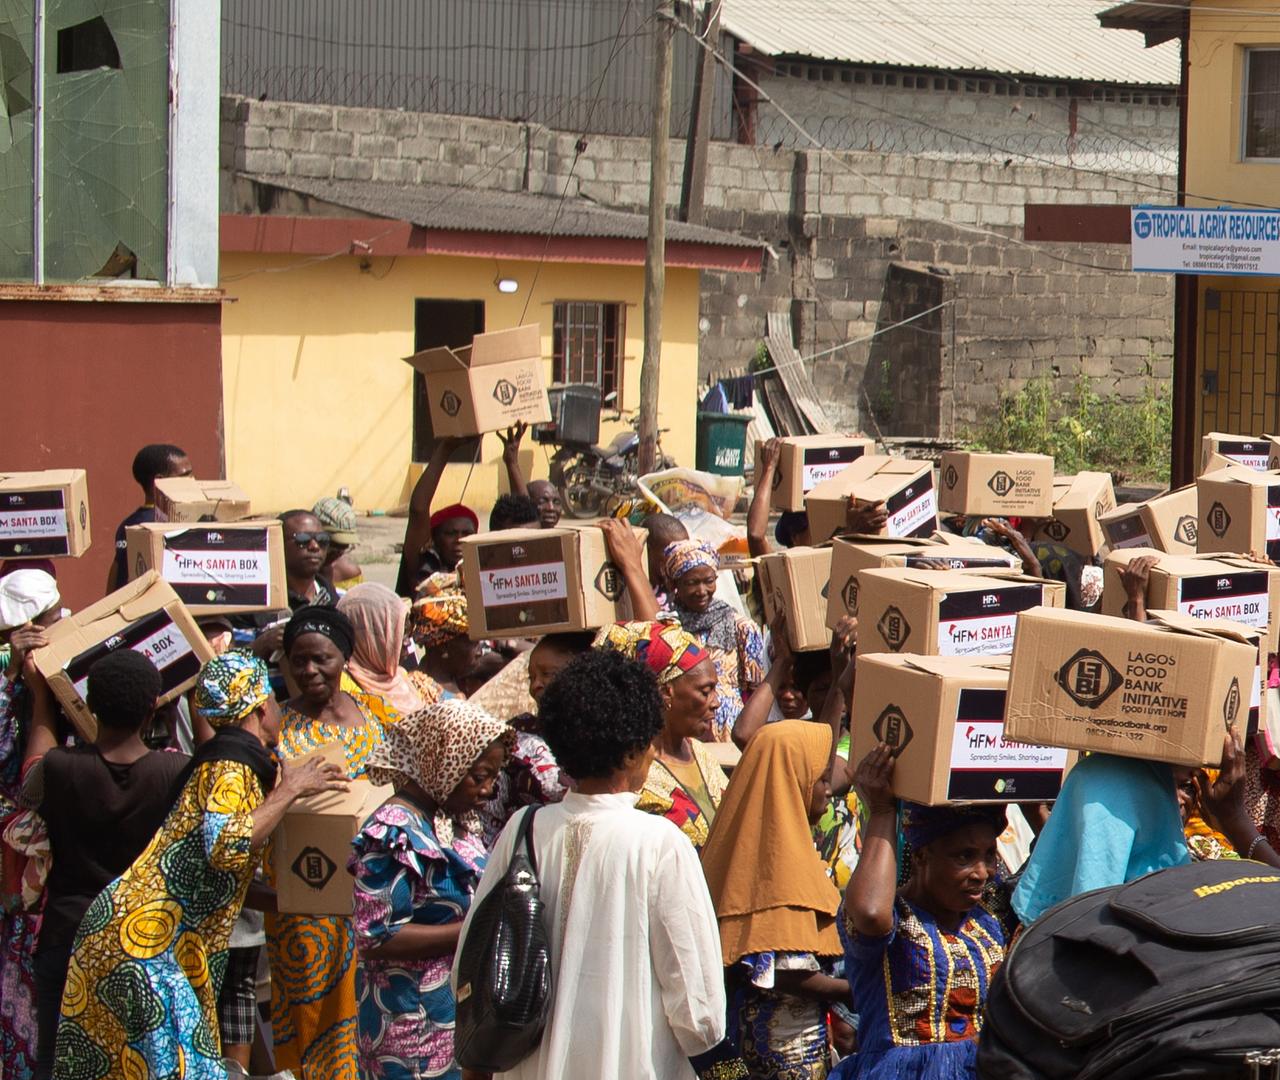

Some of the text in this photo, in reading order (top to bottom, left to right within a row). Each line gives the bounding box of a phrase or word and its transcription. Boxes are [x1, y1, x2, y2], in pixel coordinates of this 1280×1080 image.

[1152, 213, 1197, 239] TROPICAL
[1198, 215, 1227, 239] AGRIX
[1230, 215, 1280, 241] RESOURCES
[11, 516, 57, 527] SANTA BOX
[180, 559, 258, 570] HFM SANTA BOX
[493, 571, 558, 590] HFM SANTA BOX
[1192, 603, 1260, 618] HFM SANTA BOX
[953, 625, 1012, 643] HFM SANTA
[152, 634, 175, 654] BOX
[1128, 652, 1176, 666] LAGOS
[1126, 665, 1167, 679] FOOD
[1124, 679, 1163, 693] BANK
[1122, 693, 1188, 710] INITIATIVE
[1121, 706, 1187, 718] FOOD LIVE HOPE
[969, 734, 996, 749] HFM
